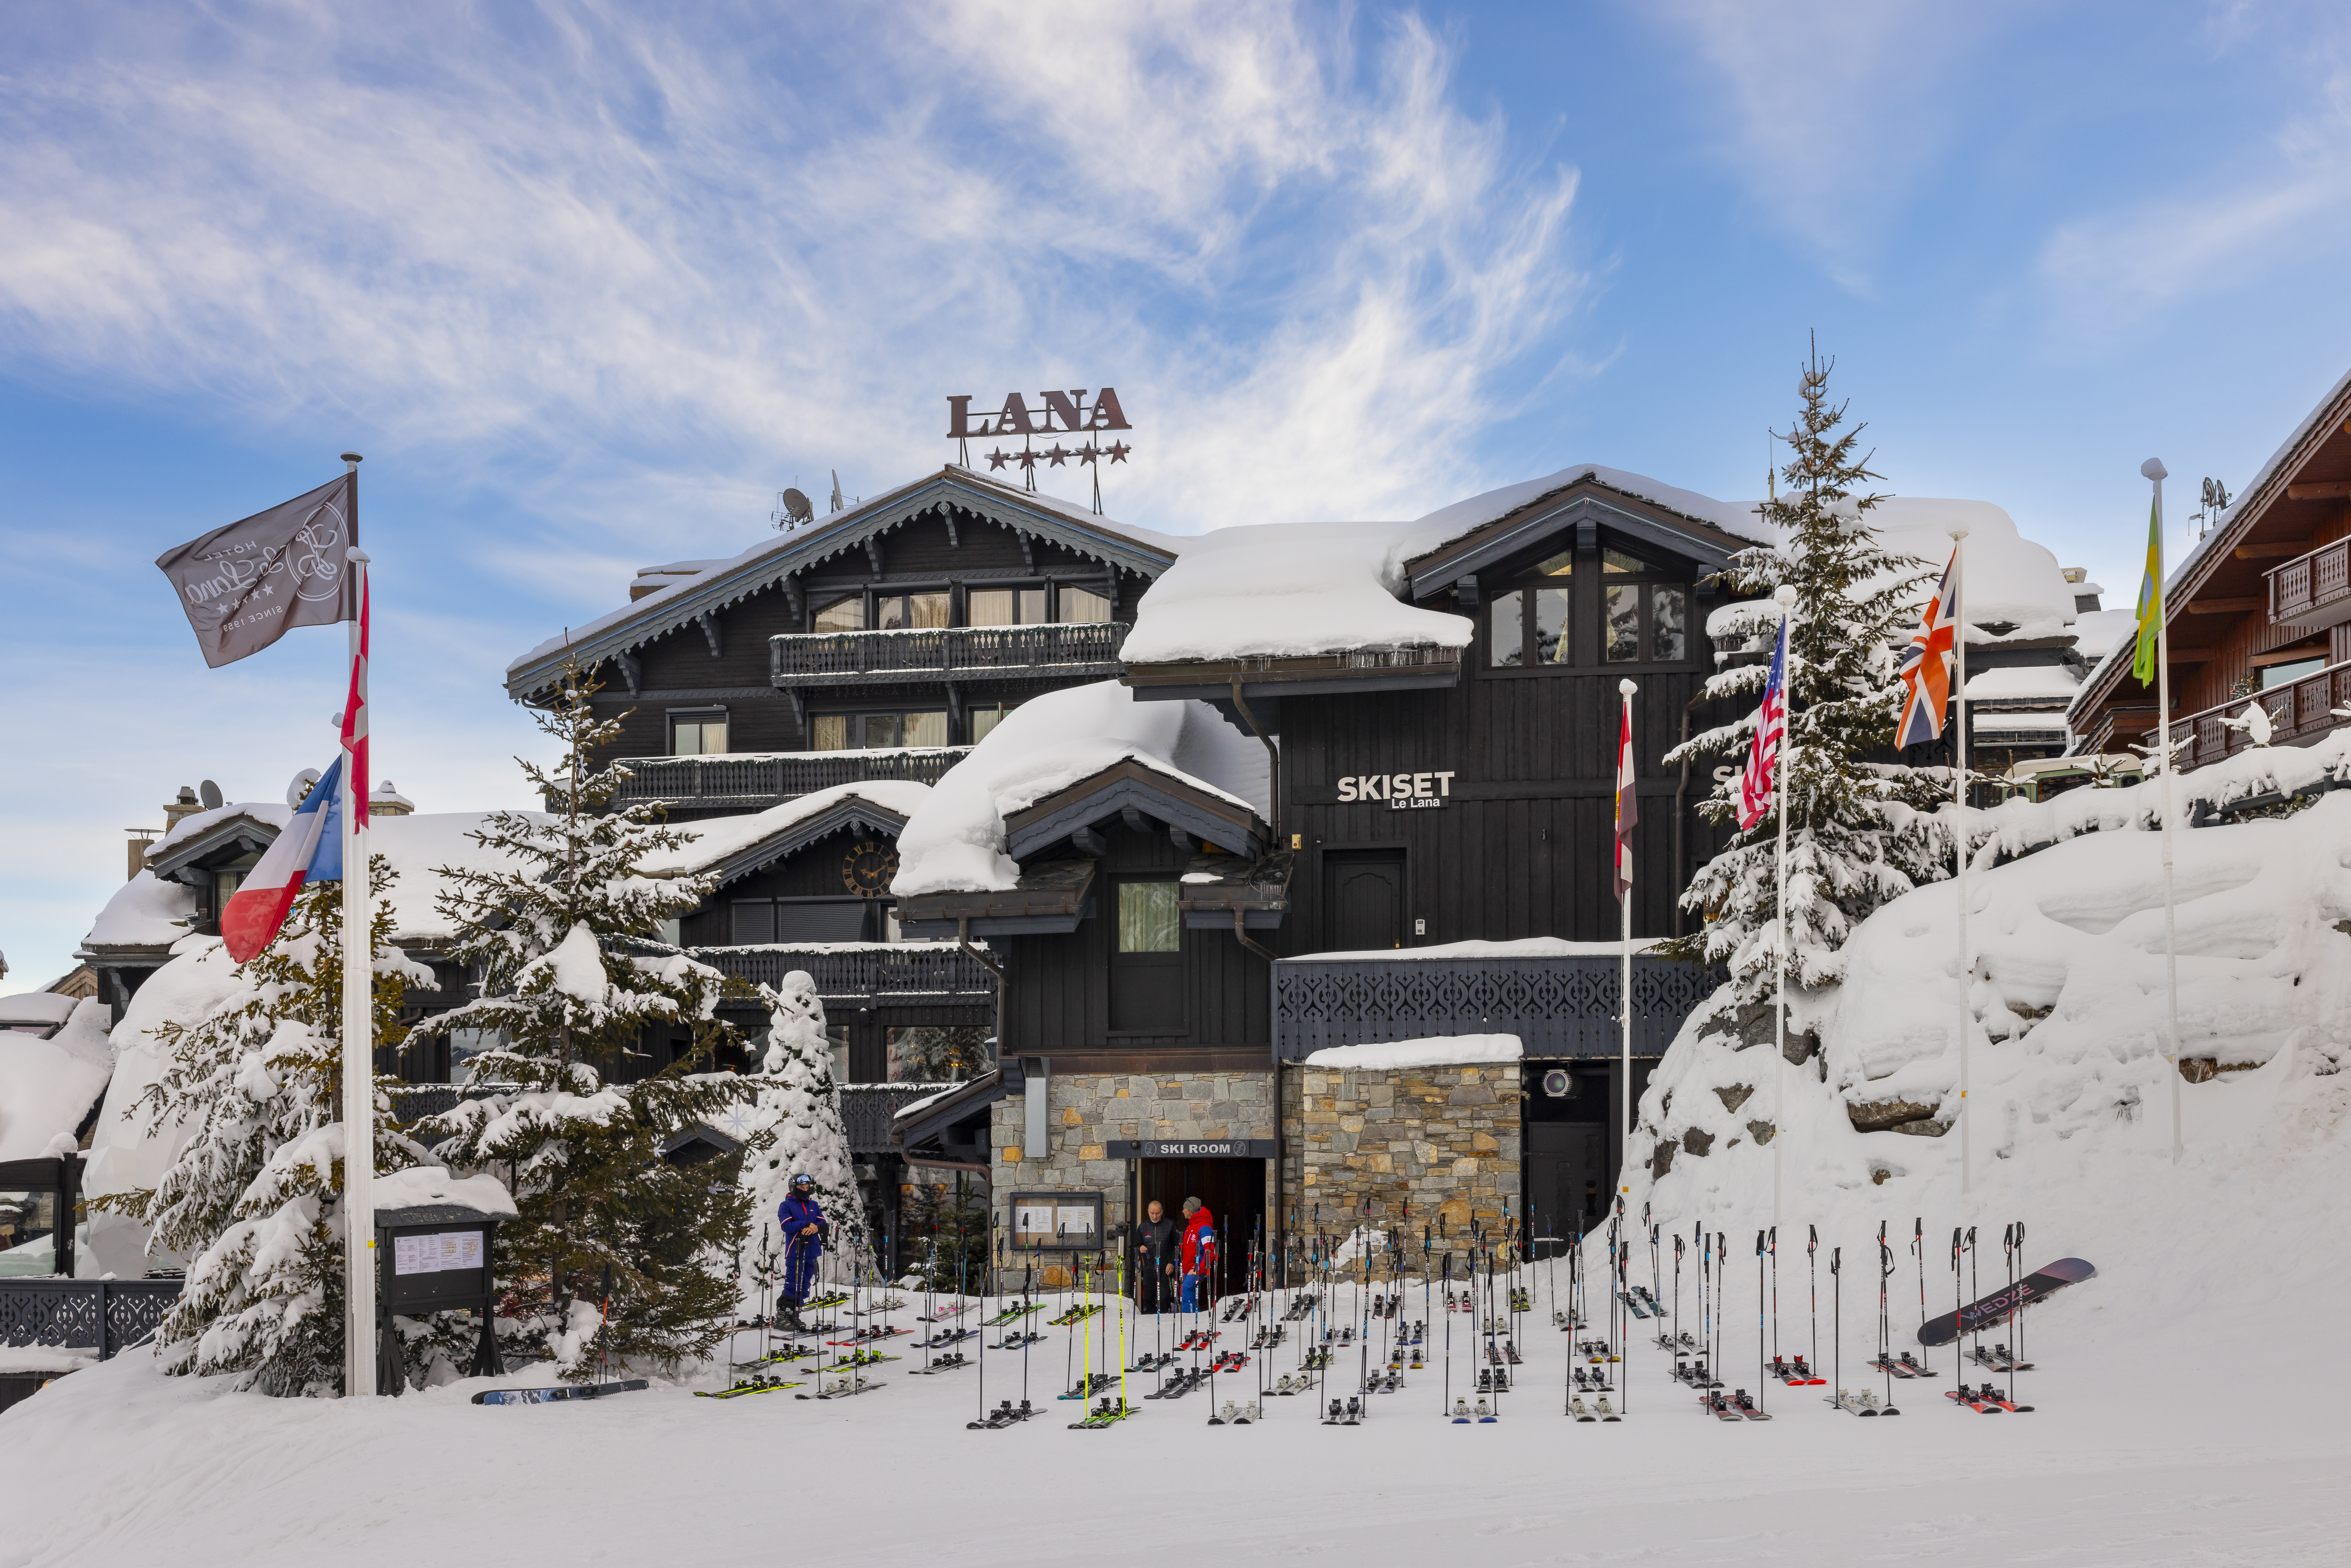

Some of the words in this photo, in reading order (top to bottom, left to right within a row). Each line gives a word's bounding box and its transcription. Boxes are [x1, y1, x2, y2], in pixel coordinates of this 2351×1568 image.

[947, 387, 1132, 438] LANA
[1337, 771, 1455, 802] SKISET
[1391, 798, 1406, 809] Le
[1410, 797, 1440, 808] Lana
[1161, 1144, 1183, 1153] SKI
[1189, 1144, 1230, 1153] ROOM
[1960, 1284, 2034, 1320] WEDZE
